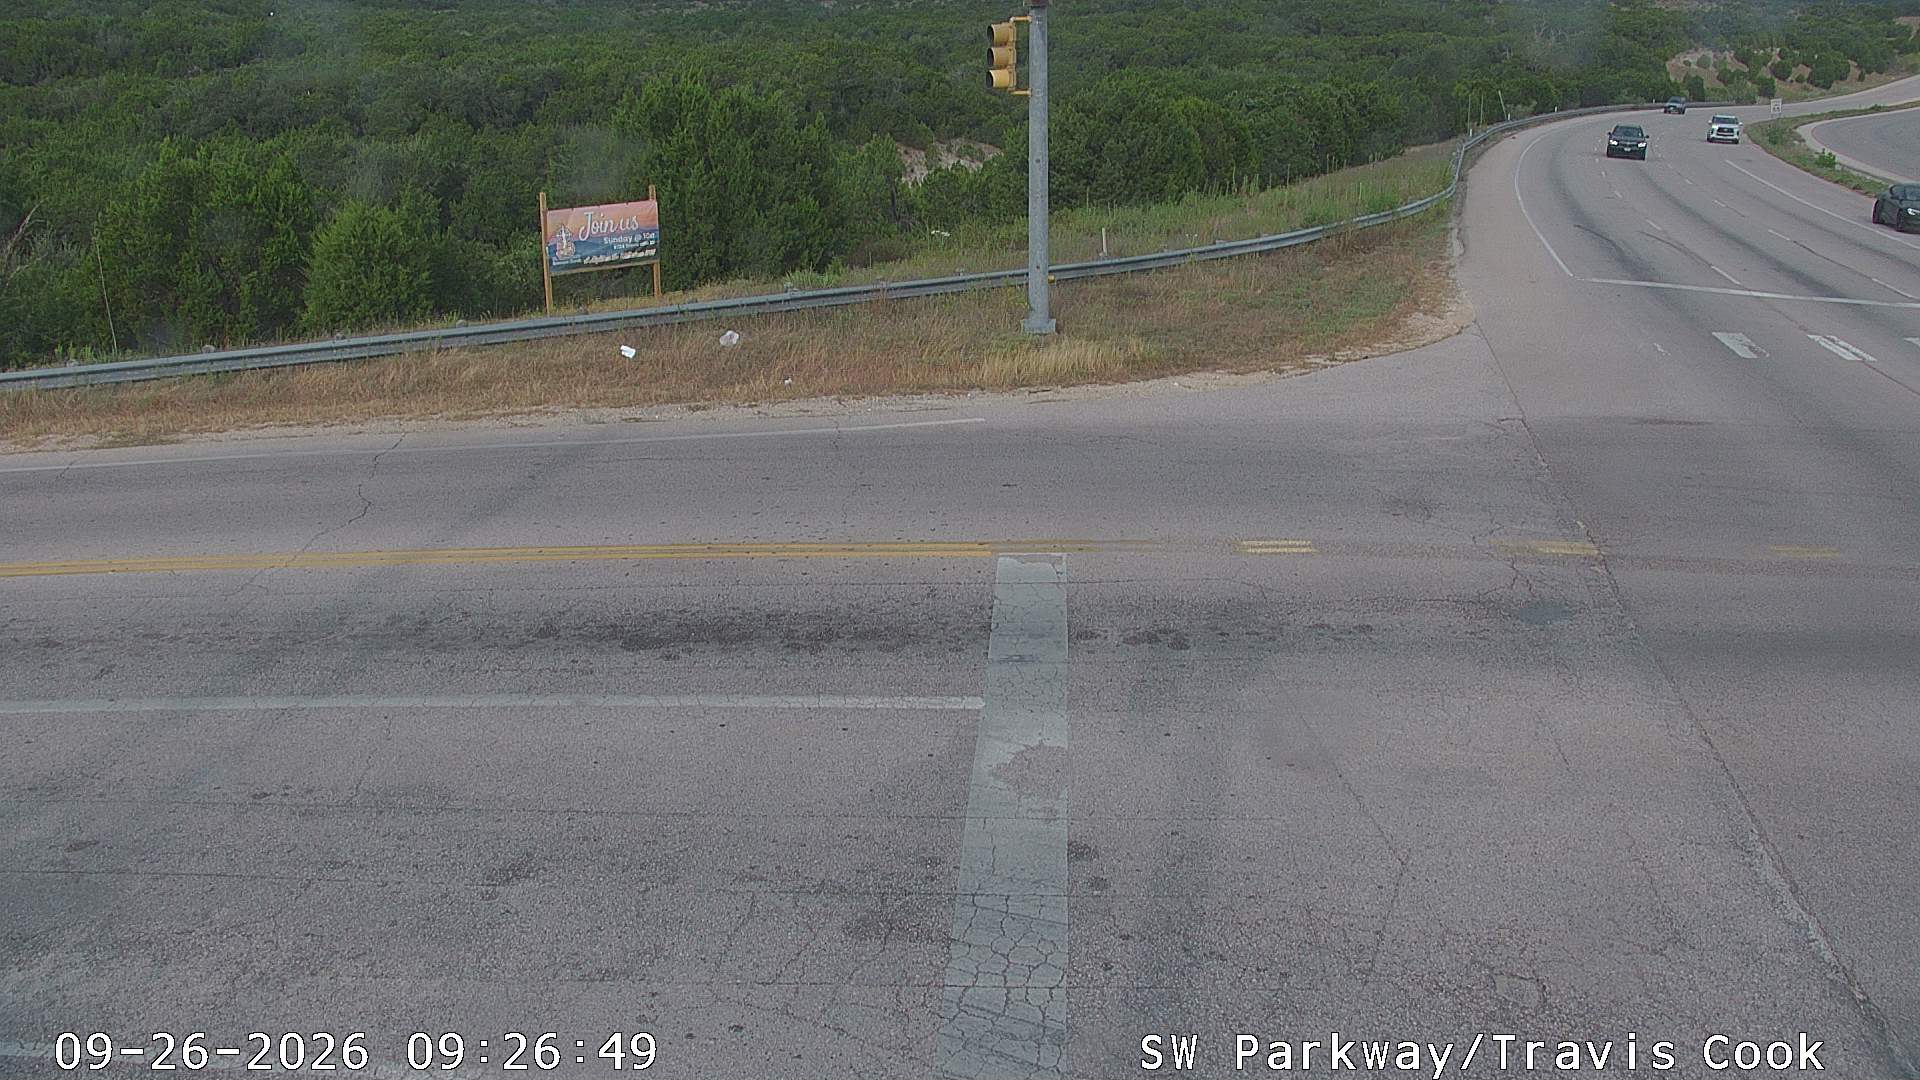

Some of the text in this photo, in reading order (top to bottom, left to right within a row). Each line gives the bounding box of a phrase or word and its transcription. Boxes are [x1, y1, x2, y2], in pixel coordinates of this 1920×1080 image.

[579, 211, 639, 241] Join us
[603, 234, 633, 245] Sunday
